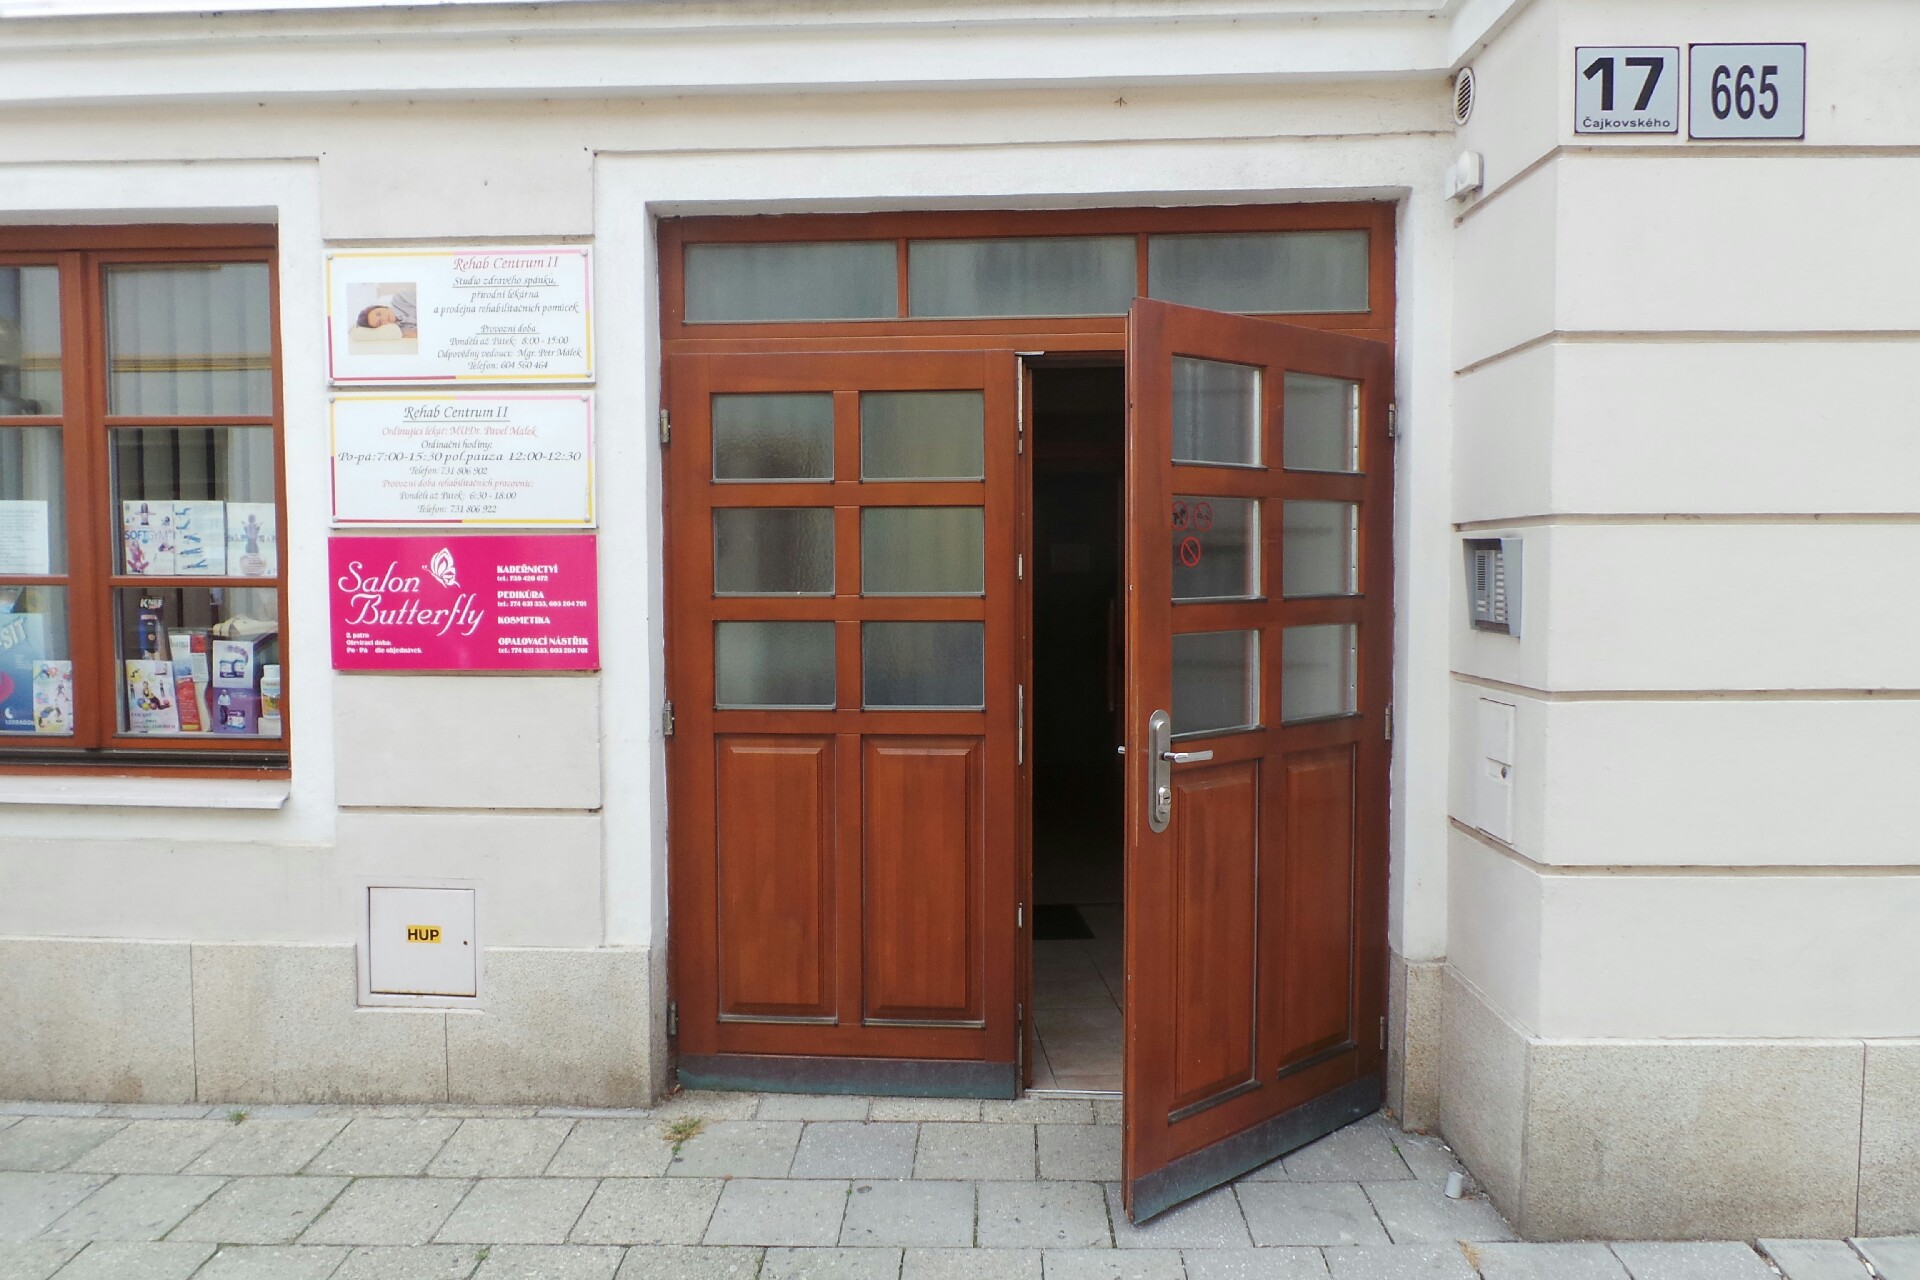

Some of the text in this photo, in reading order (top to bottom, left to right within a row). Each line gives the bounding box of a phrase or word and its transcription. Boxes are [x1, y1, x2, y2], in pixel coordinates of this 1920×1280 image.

[1582, 56, 1665, 111] 17
[1711, 64, 1780, 120] 665
[1582, 116, 1671, 131] Čajkovského
[453, 256, 559, 272] Rehab Centrum II
[453, 275, 481, 286] Studio
[483, 274, 522, 286] zdravého
[433, 306, 439, 314] a
[440, 303, 477, 317] prodejna
[517, 324, 537, 333] doba
[480, 337, 490, 345] až
[521, 337, 540, 345] 8:00
[547, 336, 569, 344] 15:00
[517, 349, 536, 360] Mgr.
[538, 348, 555, 357] Petr
[556, 348, 583, 358] Málek
[467, 361, 499, 373] Telefon:
[500, 361, 515, 369] 604
[403, 405, 509, 420] Rehab Centrum II
[449, 426, 480, 436] MUDr.
[483, 426, 510, 436] Pavel
[462, 438, 493, 451] hodiny:
[508, 451, 582, 461] 12:00-12:30
[409, 466, 440, 477] Telefon:
[441, 467, 455, 475] 731
[417, 478, 436, 487] doba
[429, 491, 439, 500] až
[469, 491, 488, 500] 6:30
[417, 504, 448, 516] Telefon:
[450, 505, 464, 513] 731
[482, 504, 497, 513] 922
[496, 563, 559, 574] KADEŘNICTVÍ
[337, 560, 421, 593] Salon
[497, 589, 545, 599] PEDIKÚRA
[344, 592, 486, 637] Butterfly
[497, 616, 551, 625] KOSMETIKA
[352, 632, 370, 640] patro
[498, 635, 589, 646] OPALOVACÍ NÁSTŘIK
[407, 928, 440, 941] HUP
